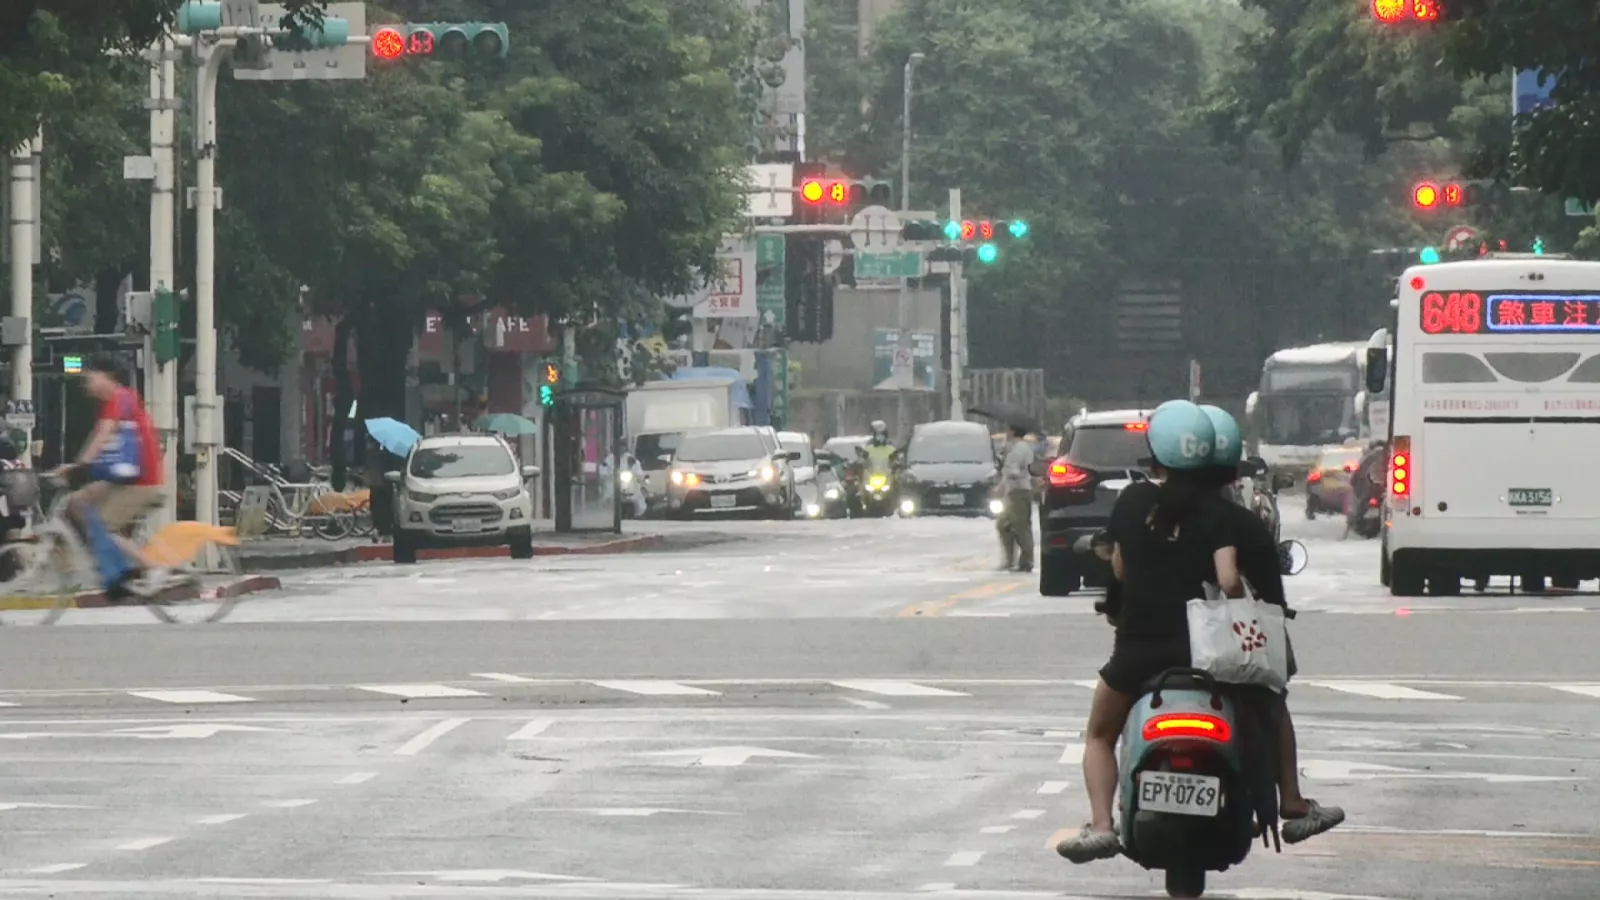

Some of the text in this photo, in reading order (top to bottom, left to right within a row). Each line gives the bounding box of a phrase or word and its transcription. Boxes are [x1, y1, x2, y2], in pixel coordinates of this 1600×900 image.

[1422, 293, 1481, 333] 648
[1498, 301, 1600, 327] 煞車注
[1181, 433, 1211, 458] Go
[1142, 781, 1217, 806] EPY-0769
